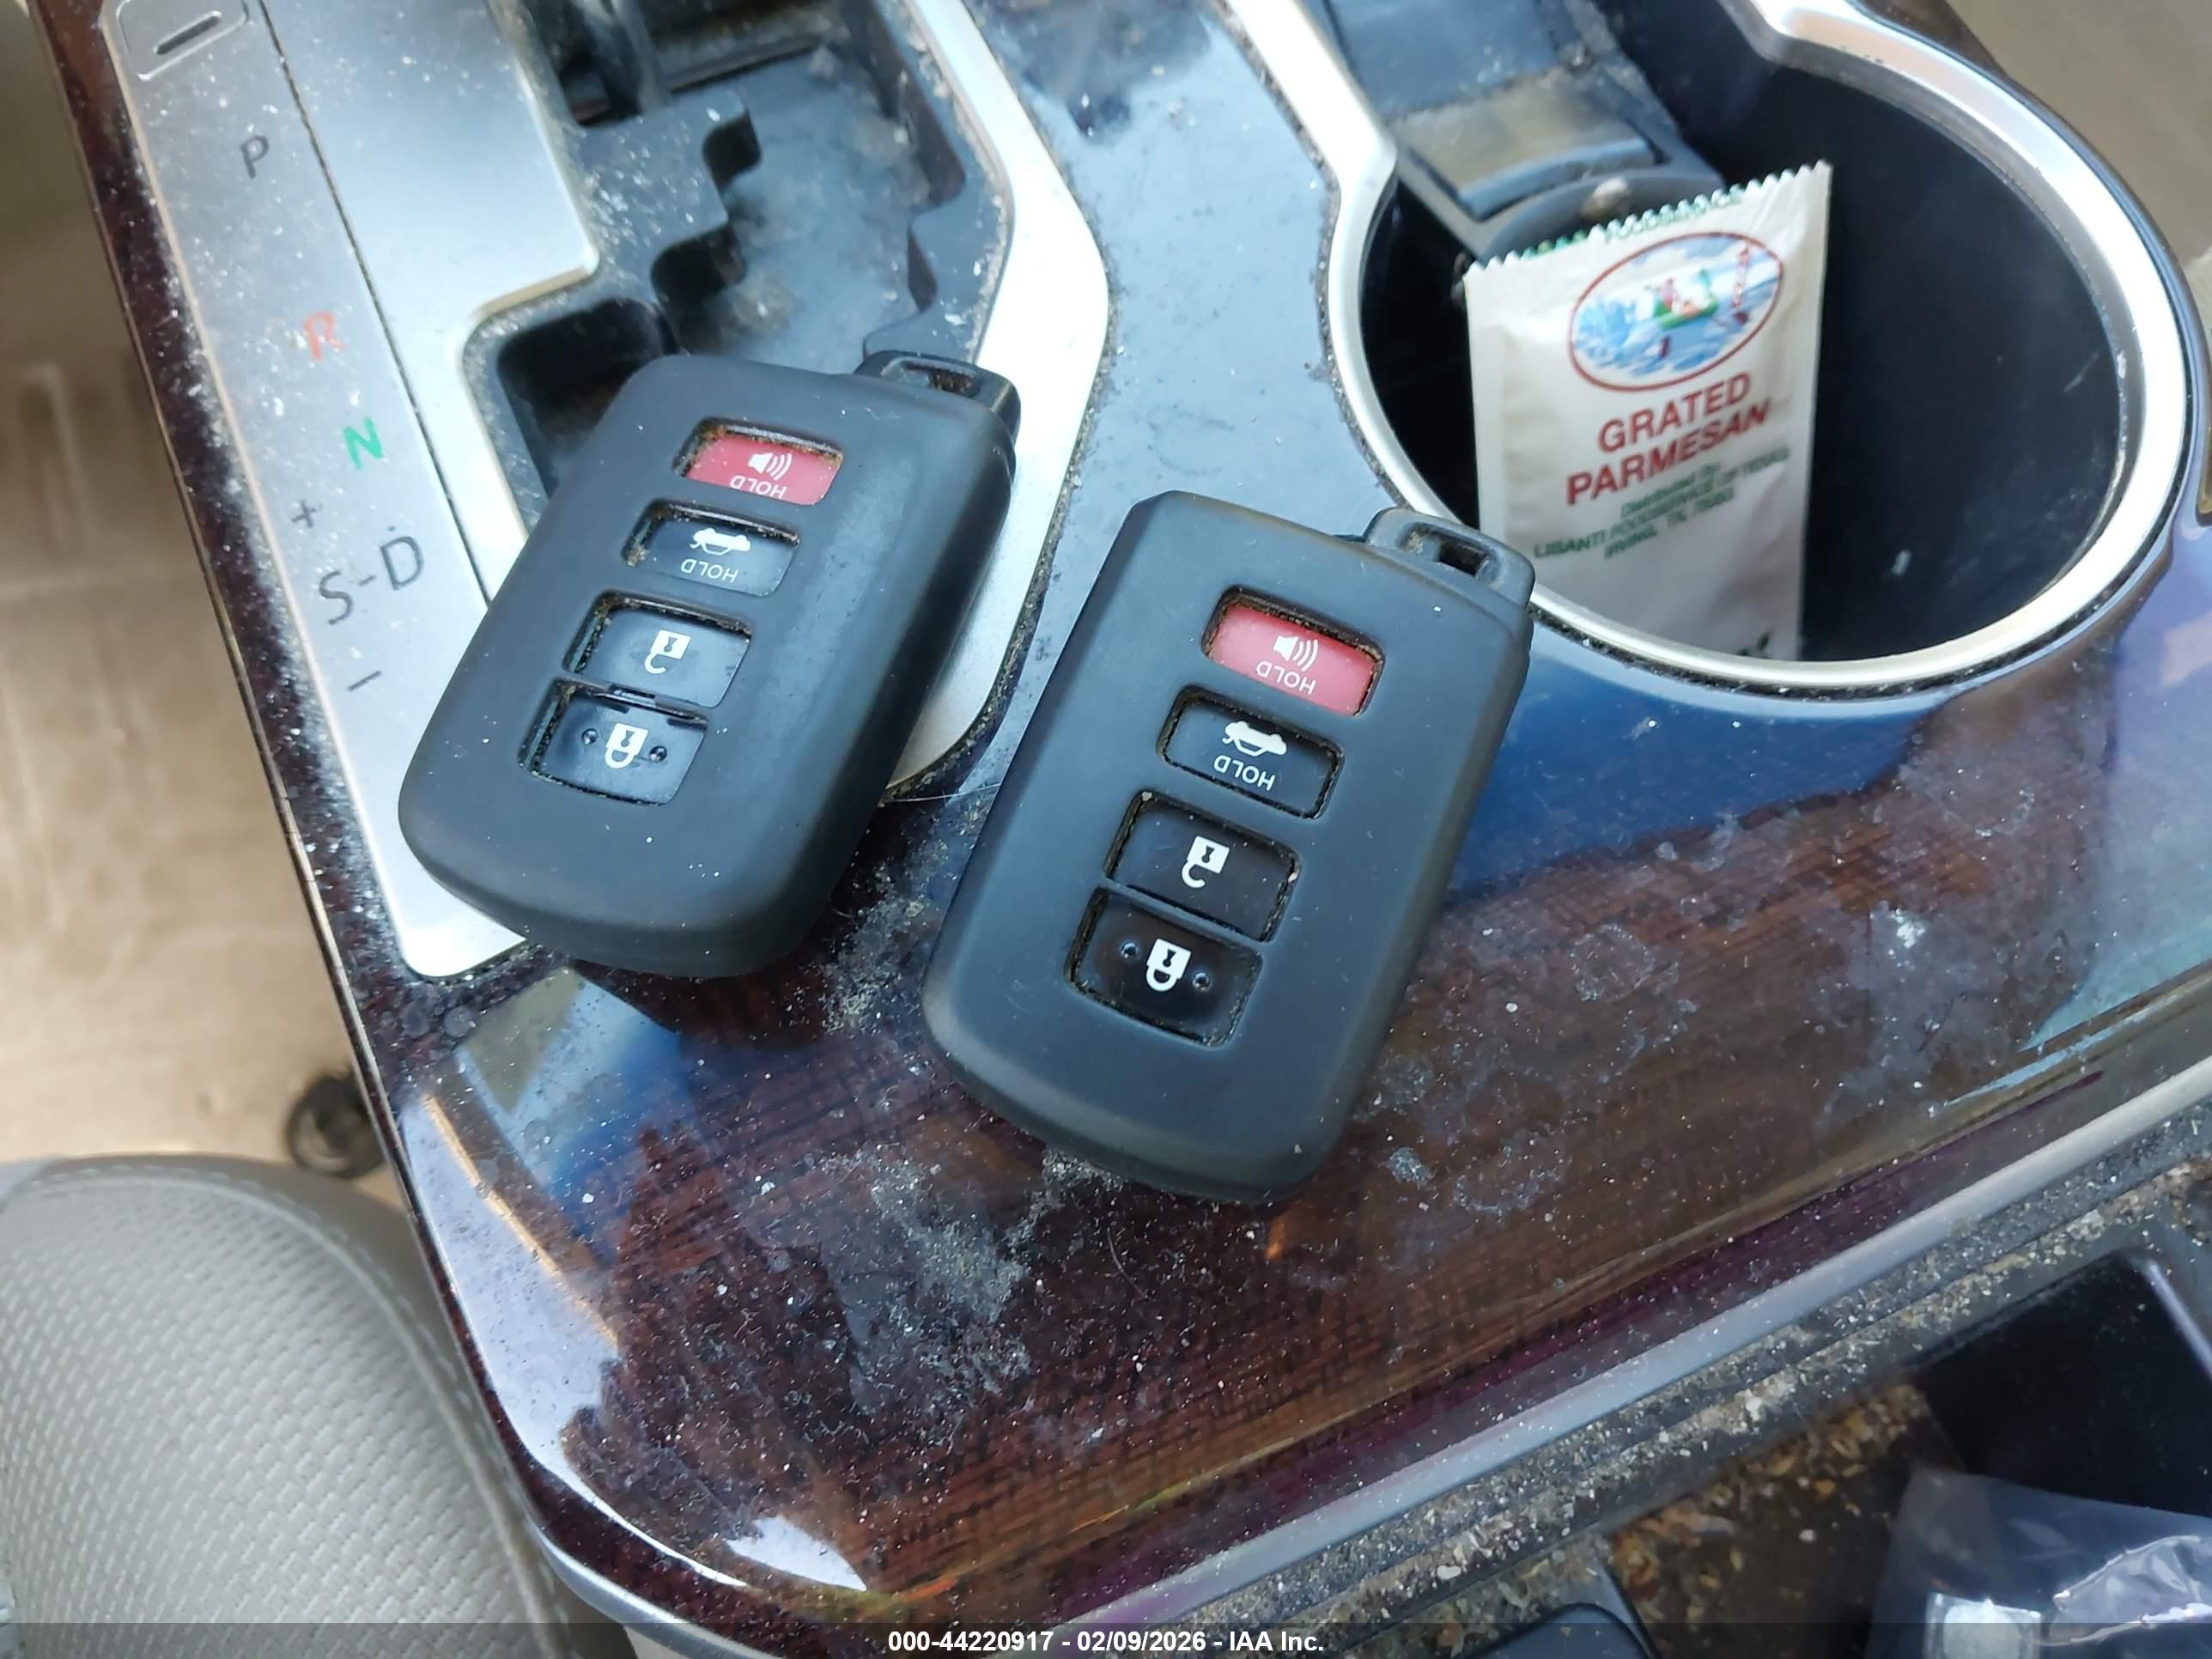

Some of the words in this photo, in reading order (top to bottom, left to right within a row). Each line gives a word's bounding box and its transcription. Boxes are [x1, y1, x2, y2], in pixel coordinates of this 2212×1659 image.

[240, 134, 270, 179] P
[304, 311, 345, 362] R
[1598, 373, 1752, 454] GRATED
[343, 416, 385, 471] N
[1566, 398, 1771, 506] PARMESAN
[730, 474, 787, 500] HOLD
[680, 558, 739, 584] HOLD
[1256, 660, 1316, 695] HOLD
[1213, 755, 1276, 791] HOLD
